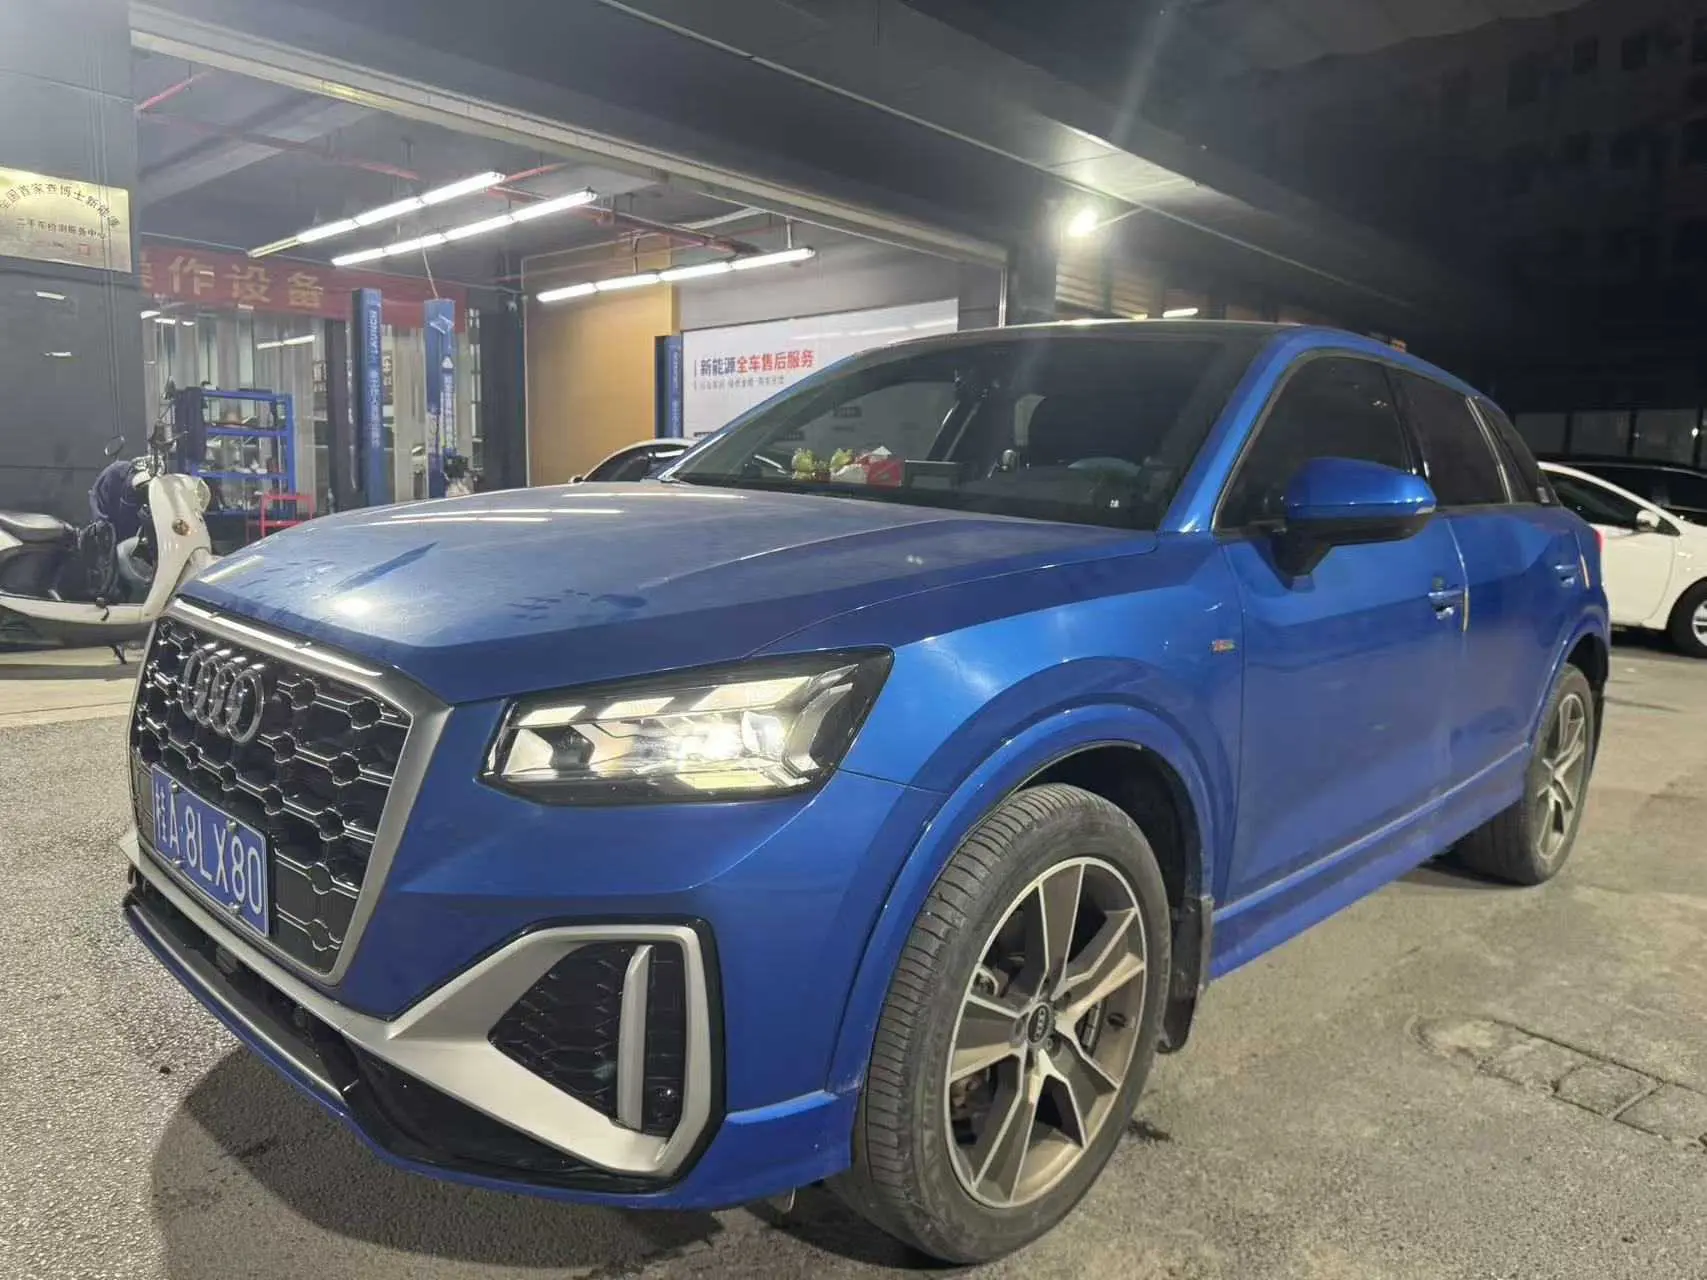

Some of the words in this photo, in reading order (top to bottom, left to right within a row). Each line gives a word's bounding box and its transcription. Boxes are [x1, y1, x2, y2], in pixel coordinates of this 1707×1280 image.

[701, 349, 814, 377] 新能源全车售后服务
